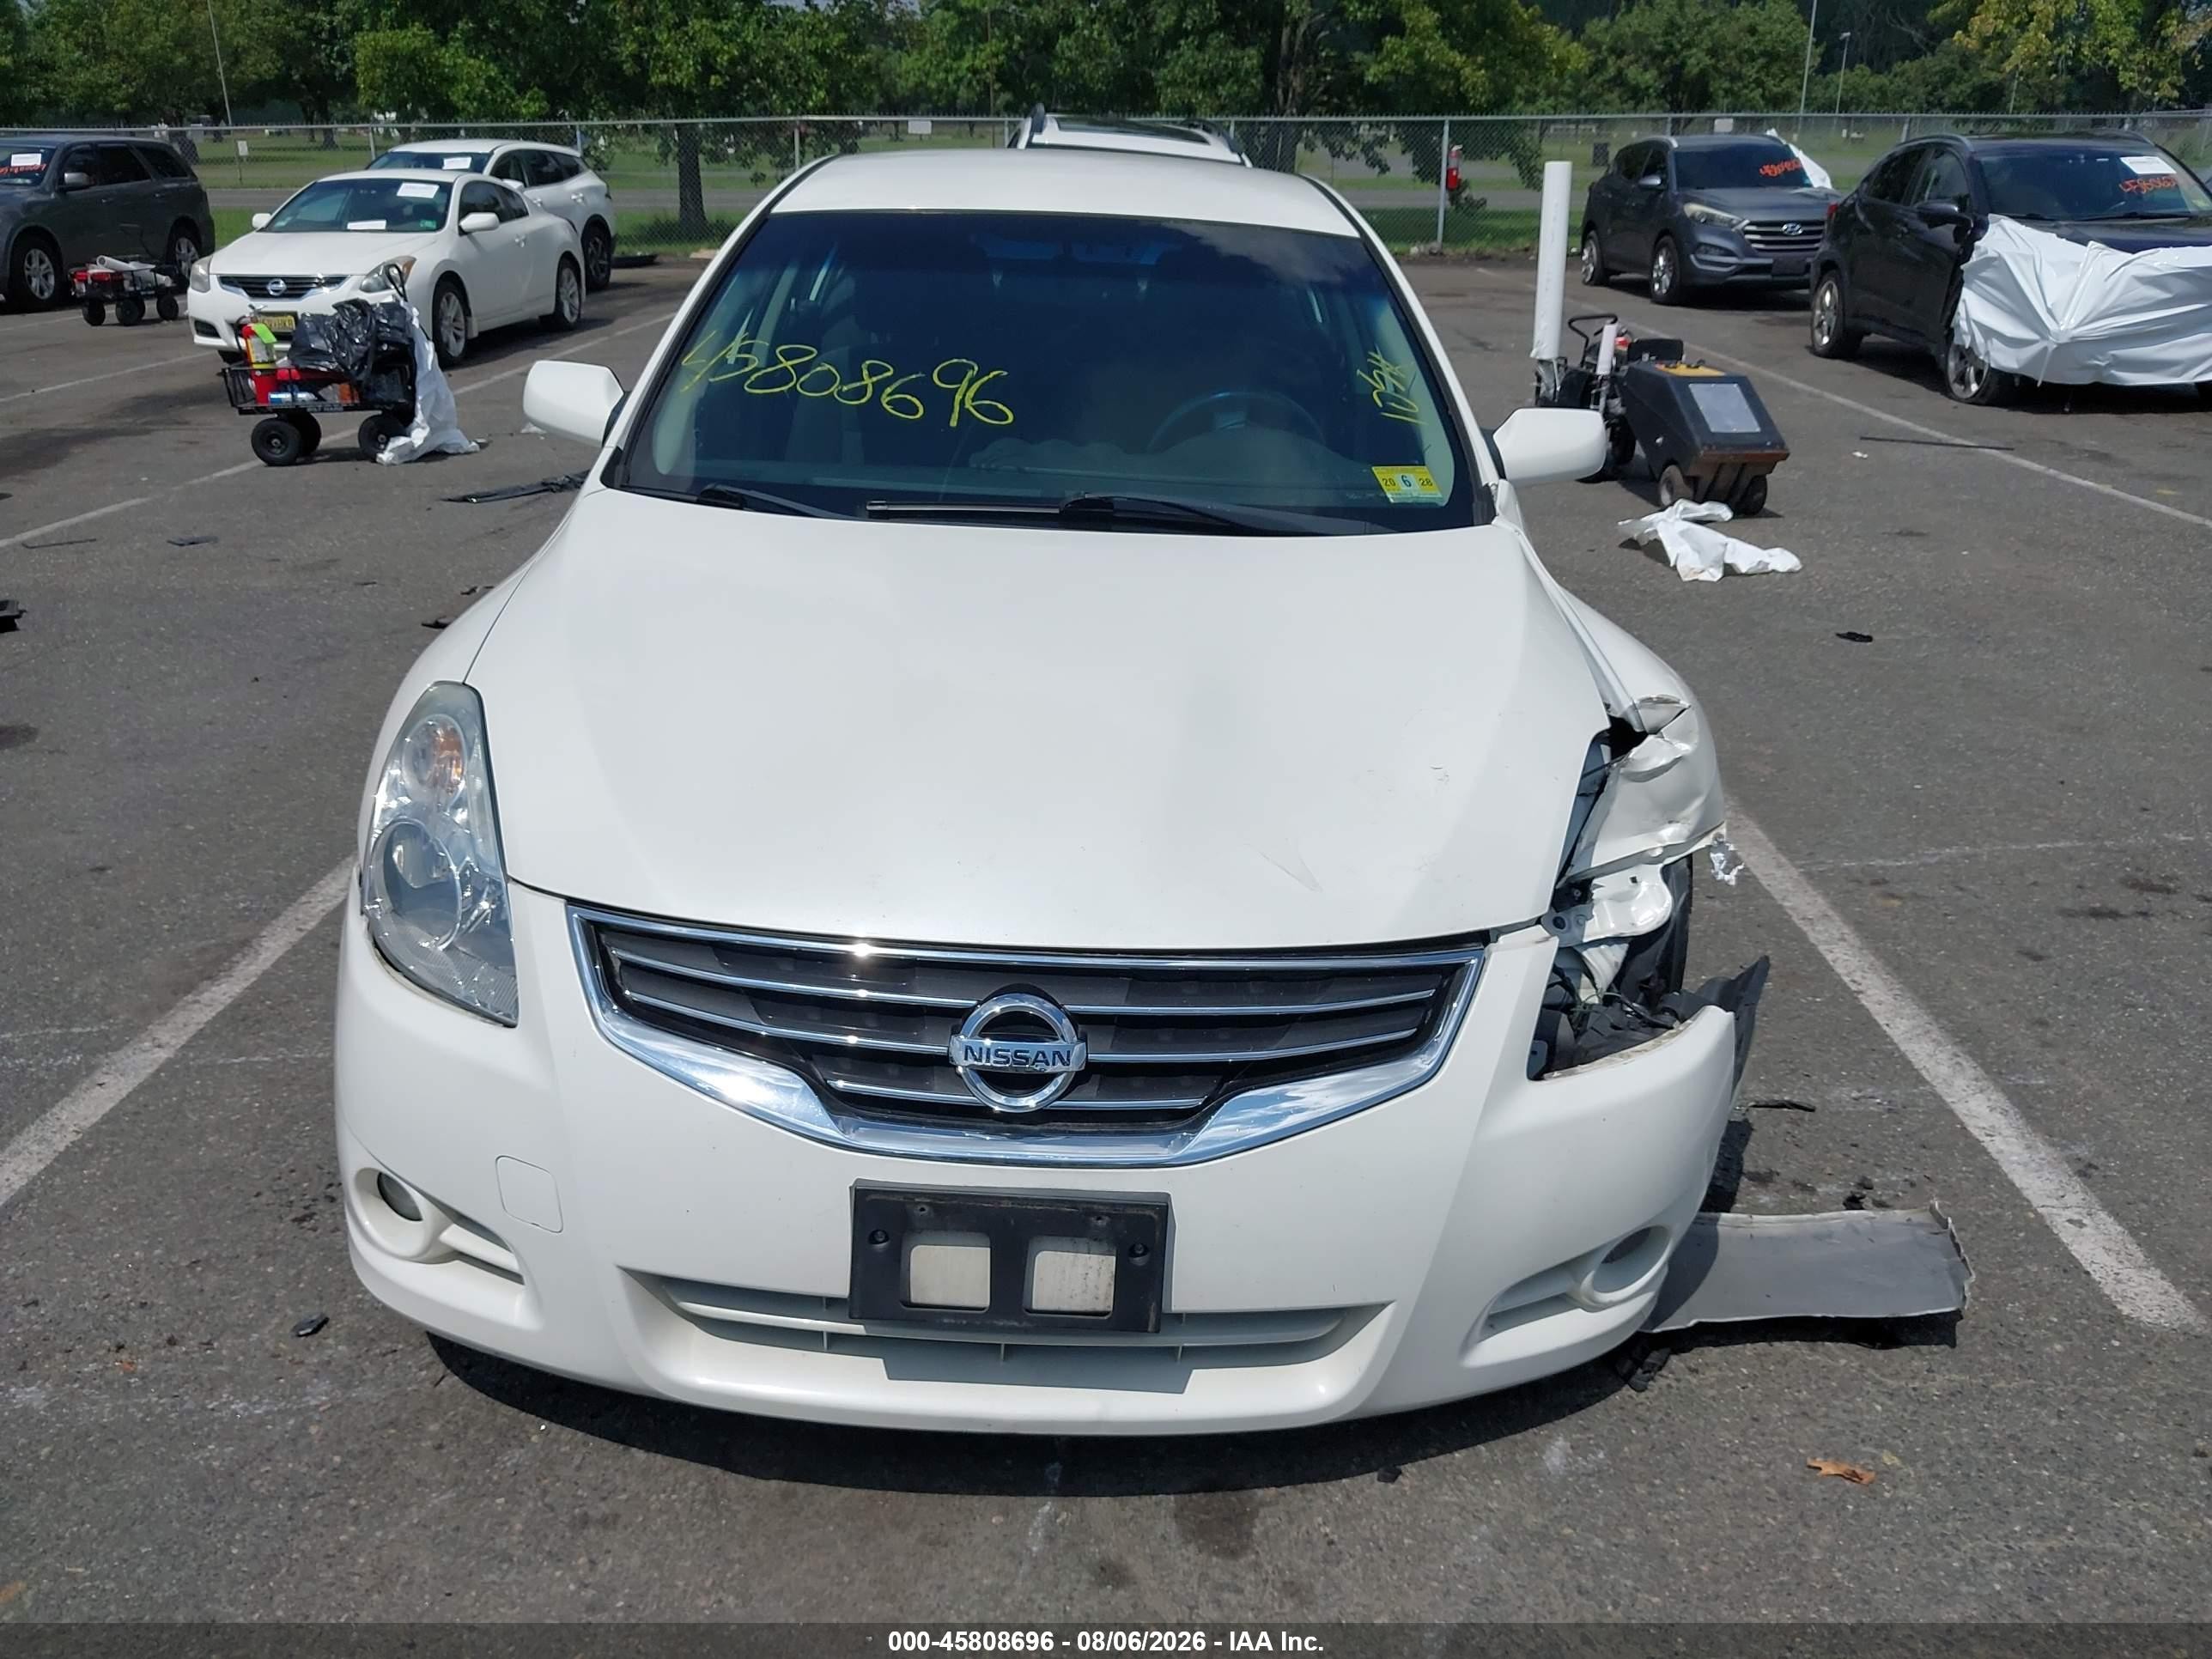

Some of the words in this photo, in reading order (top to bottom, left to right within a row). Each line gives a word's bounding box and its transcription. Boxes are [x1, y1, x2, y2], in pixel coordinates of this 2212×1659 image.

[681, 331, 1014, 428] 45808696
[1382, 477, 1396, 487] 20
[1401, 474, 1412, 488] 6
[1419, 477, 1433, 487] 28
[963, 1044, 1071, 1067] NISSAN
